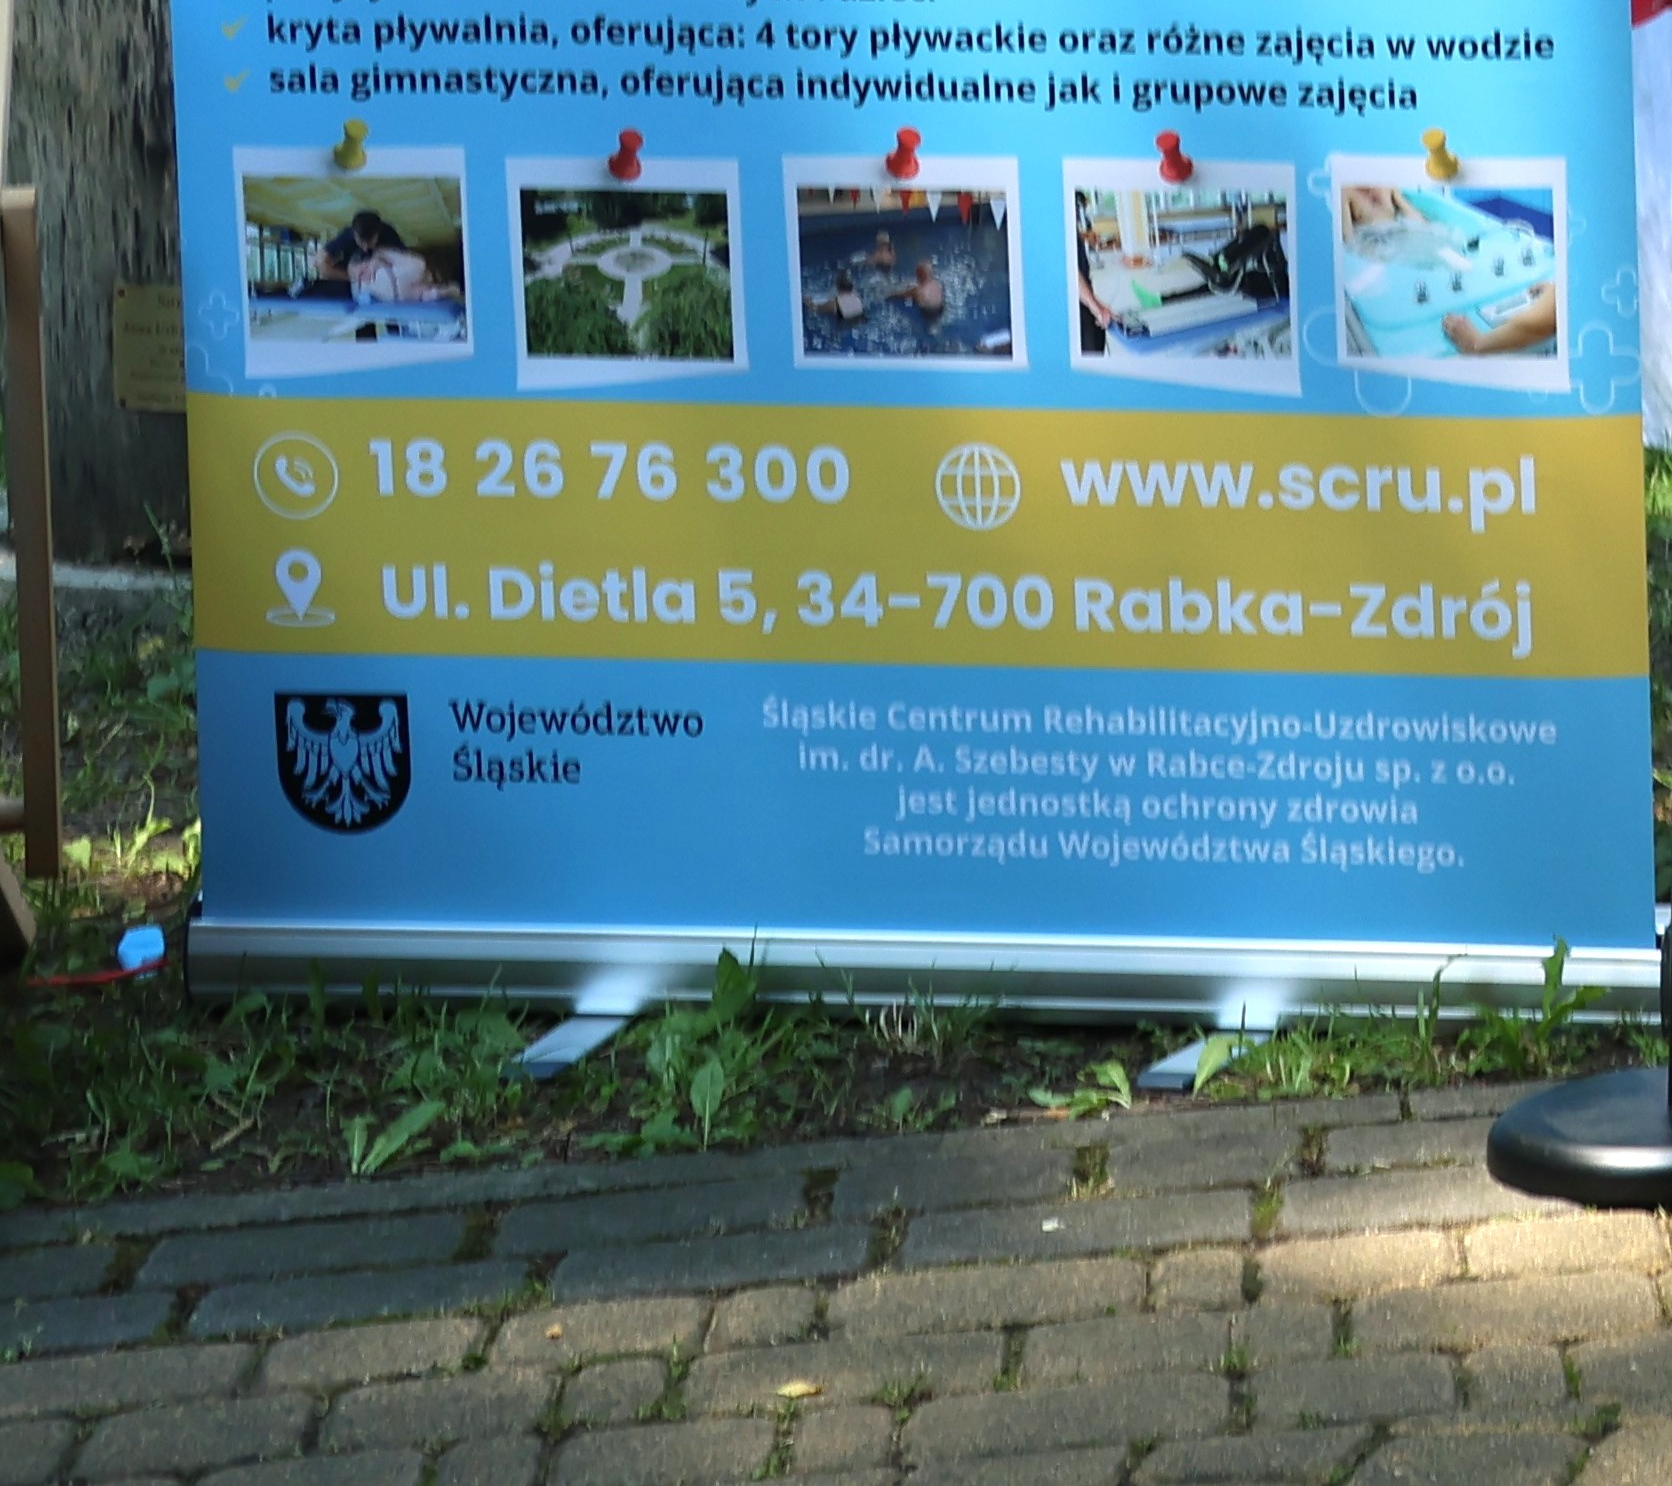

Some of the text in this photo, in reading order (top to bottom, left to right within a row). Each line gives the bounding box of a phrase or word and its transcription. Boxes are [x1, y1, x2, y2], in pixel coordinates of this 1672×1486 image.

[368, 434, 850, 505] 18 26 76 300
[1060, 453, 1538, 532] www.scru.pl
[382, 558, 1539, 661] Ul. Dietla 5, 34-700 Rabka-Zdrój
[447, 697, 704, 744] Województwo
[762, 694, 1557, 746] Śląskie Centrum Rehabilitacyjno-Uzdrowiskowe
[452, 742, 581, 791] Śląskie
[895, 784, 1418, 830] jest jednostką ochrony zdrowia
[863, 825, 1464, 874] Samorządu Województwa Śląskiego.
